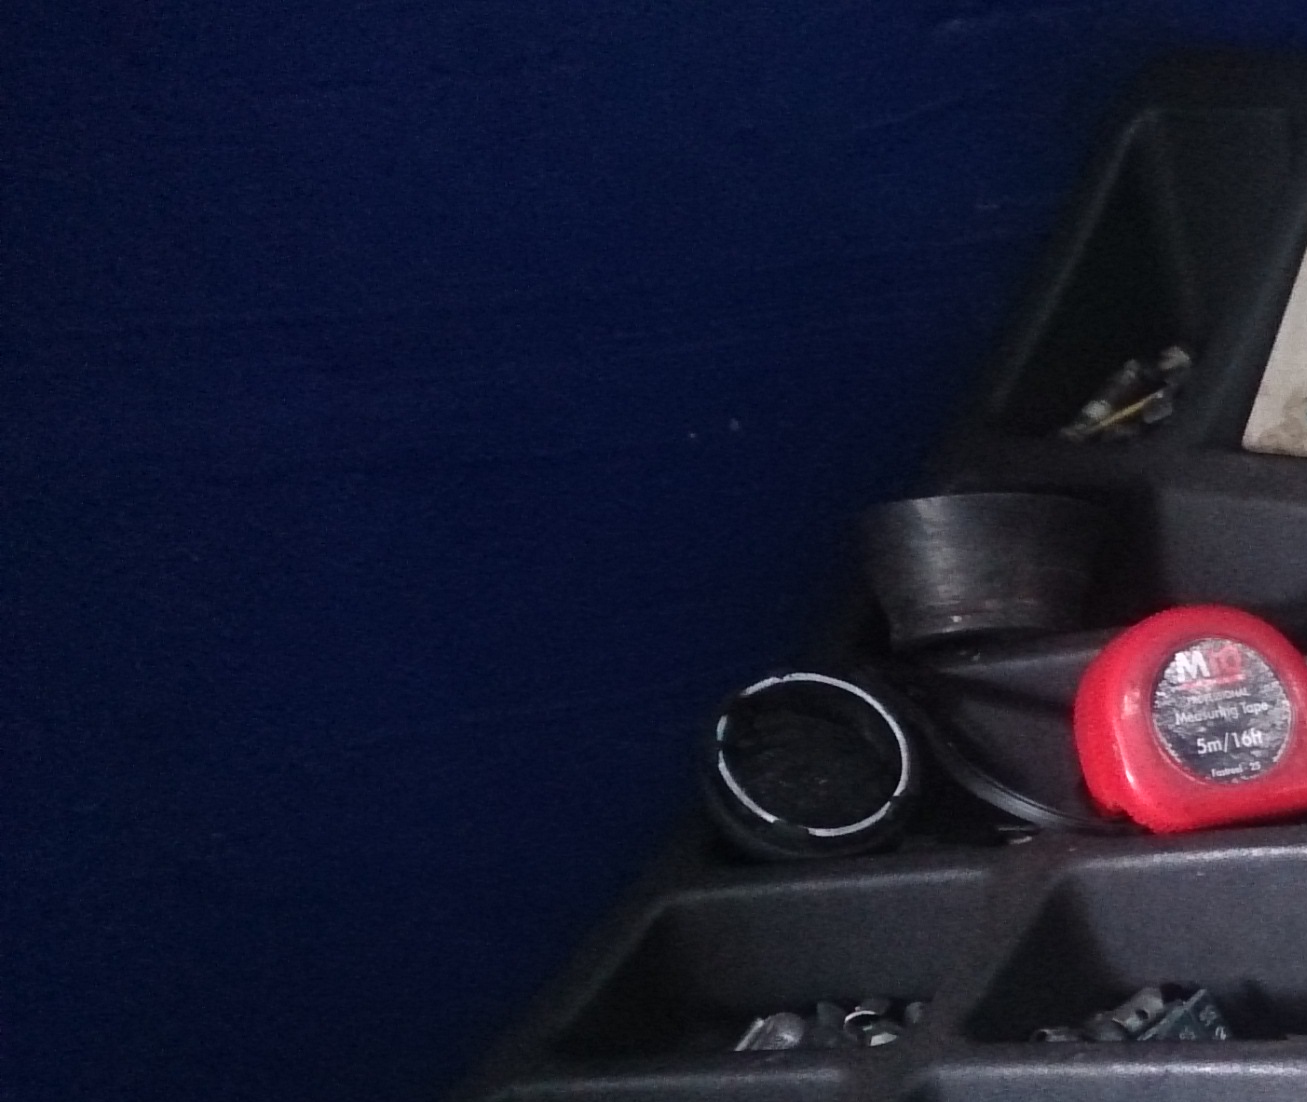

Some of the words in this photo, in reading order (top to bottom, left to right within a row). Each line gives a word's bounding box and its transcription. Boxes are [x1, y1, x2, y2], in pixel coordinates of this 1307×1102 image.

[1175, 705, 1239, 725] Measuring
[1240, 701, 1269, 716] Tape
[1196, 727, 1263, 754] 5m/16ft
